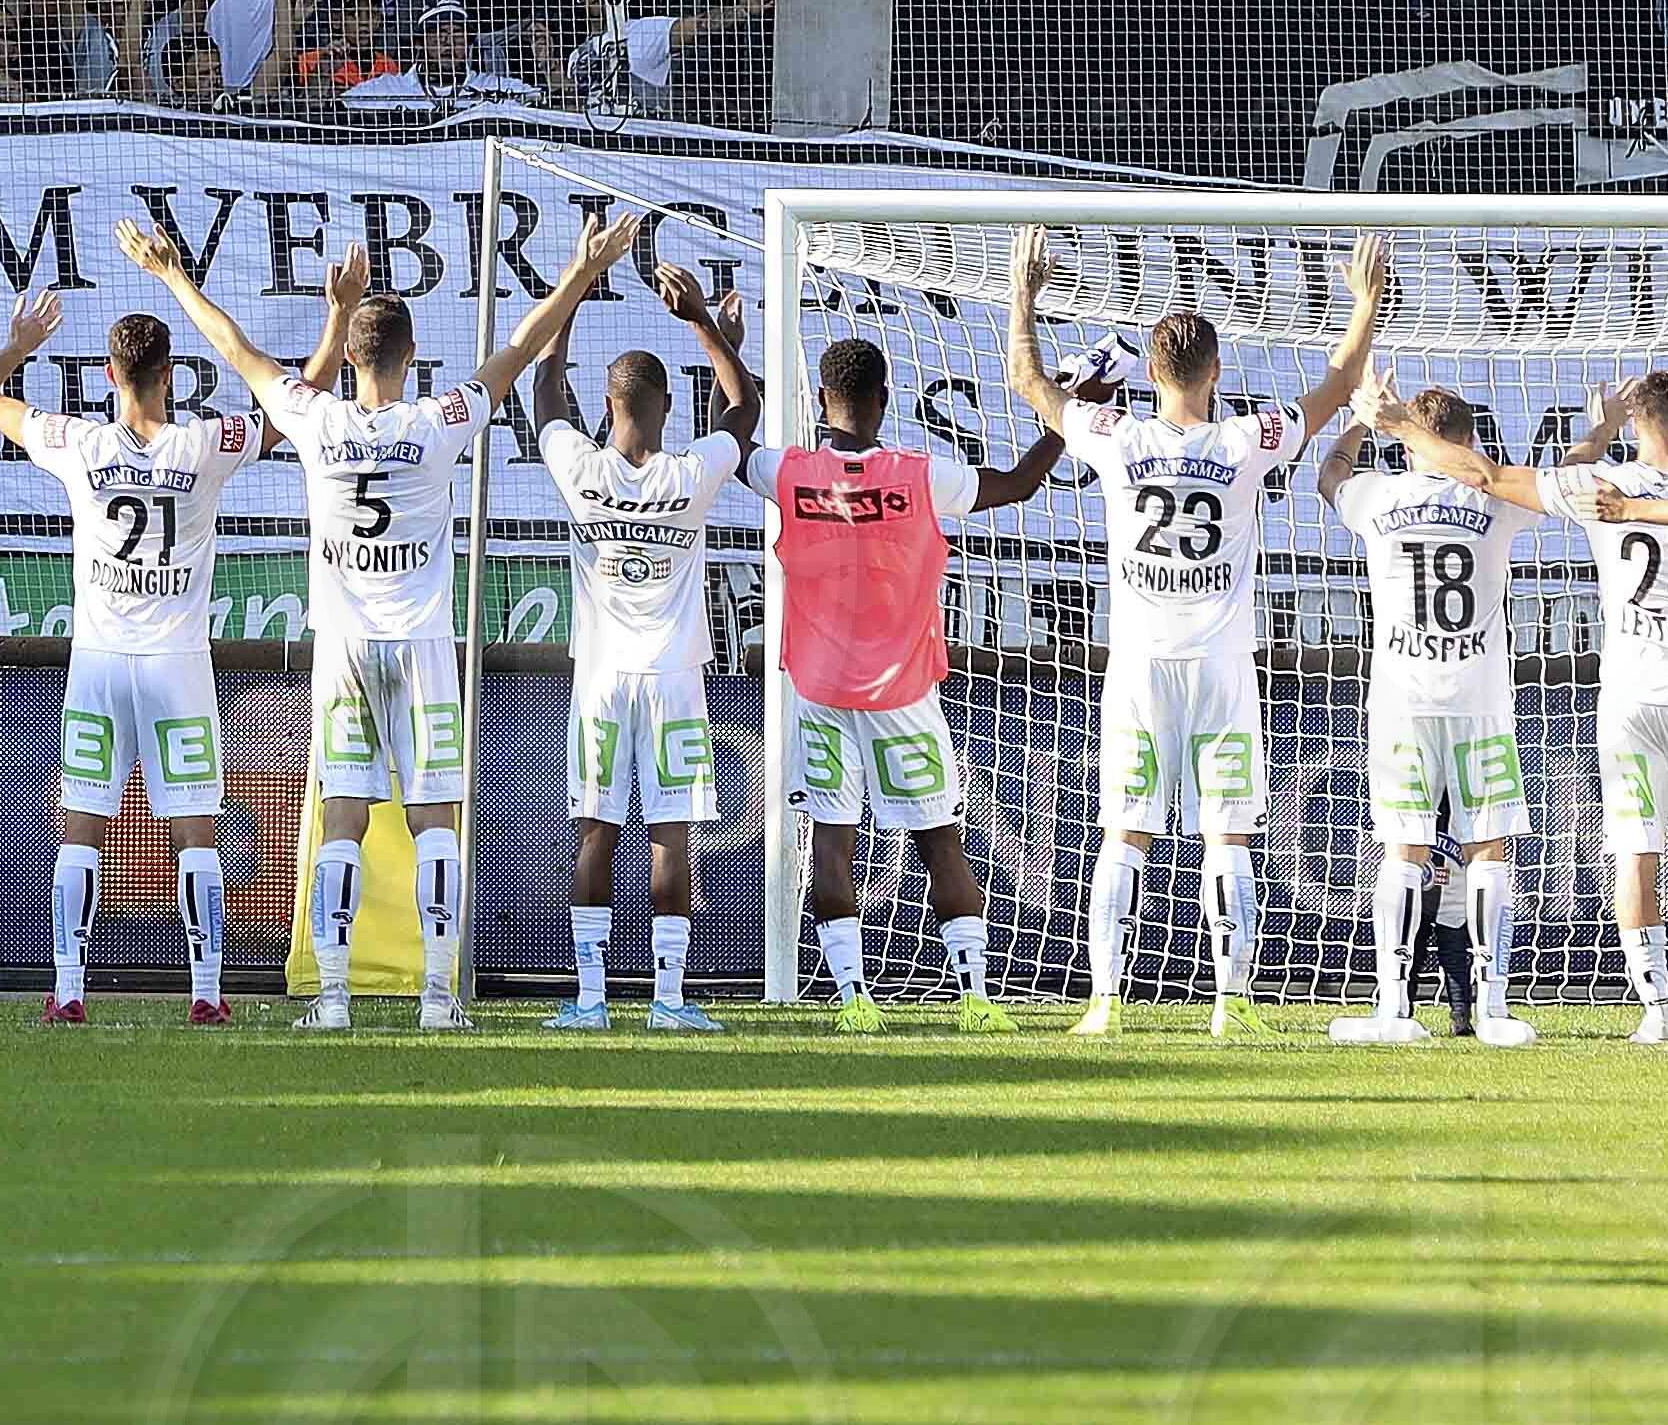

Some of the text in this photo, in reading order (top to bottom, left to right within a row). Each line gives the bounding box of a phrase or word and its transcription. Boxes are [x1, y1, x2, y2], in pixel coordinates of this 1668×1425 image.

[90, 467, 196, 493] PUNTIGAMER
[351, 470, 391, 539] 5
[105, 494, 176, 566] 21
[575, 522, 698, 551] PUNTIGAMER
[1134, 485, 1224, 559] 23
[1375, 505, 1491, 535] PUNTIGAMER
[1400, 541, 1476, 633] 18
